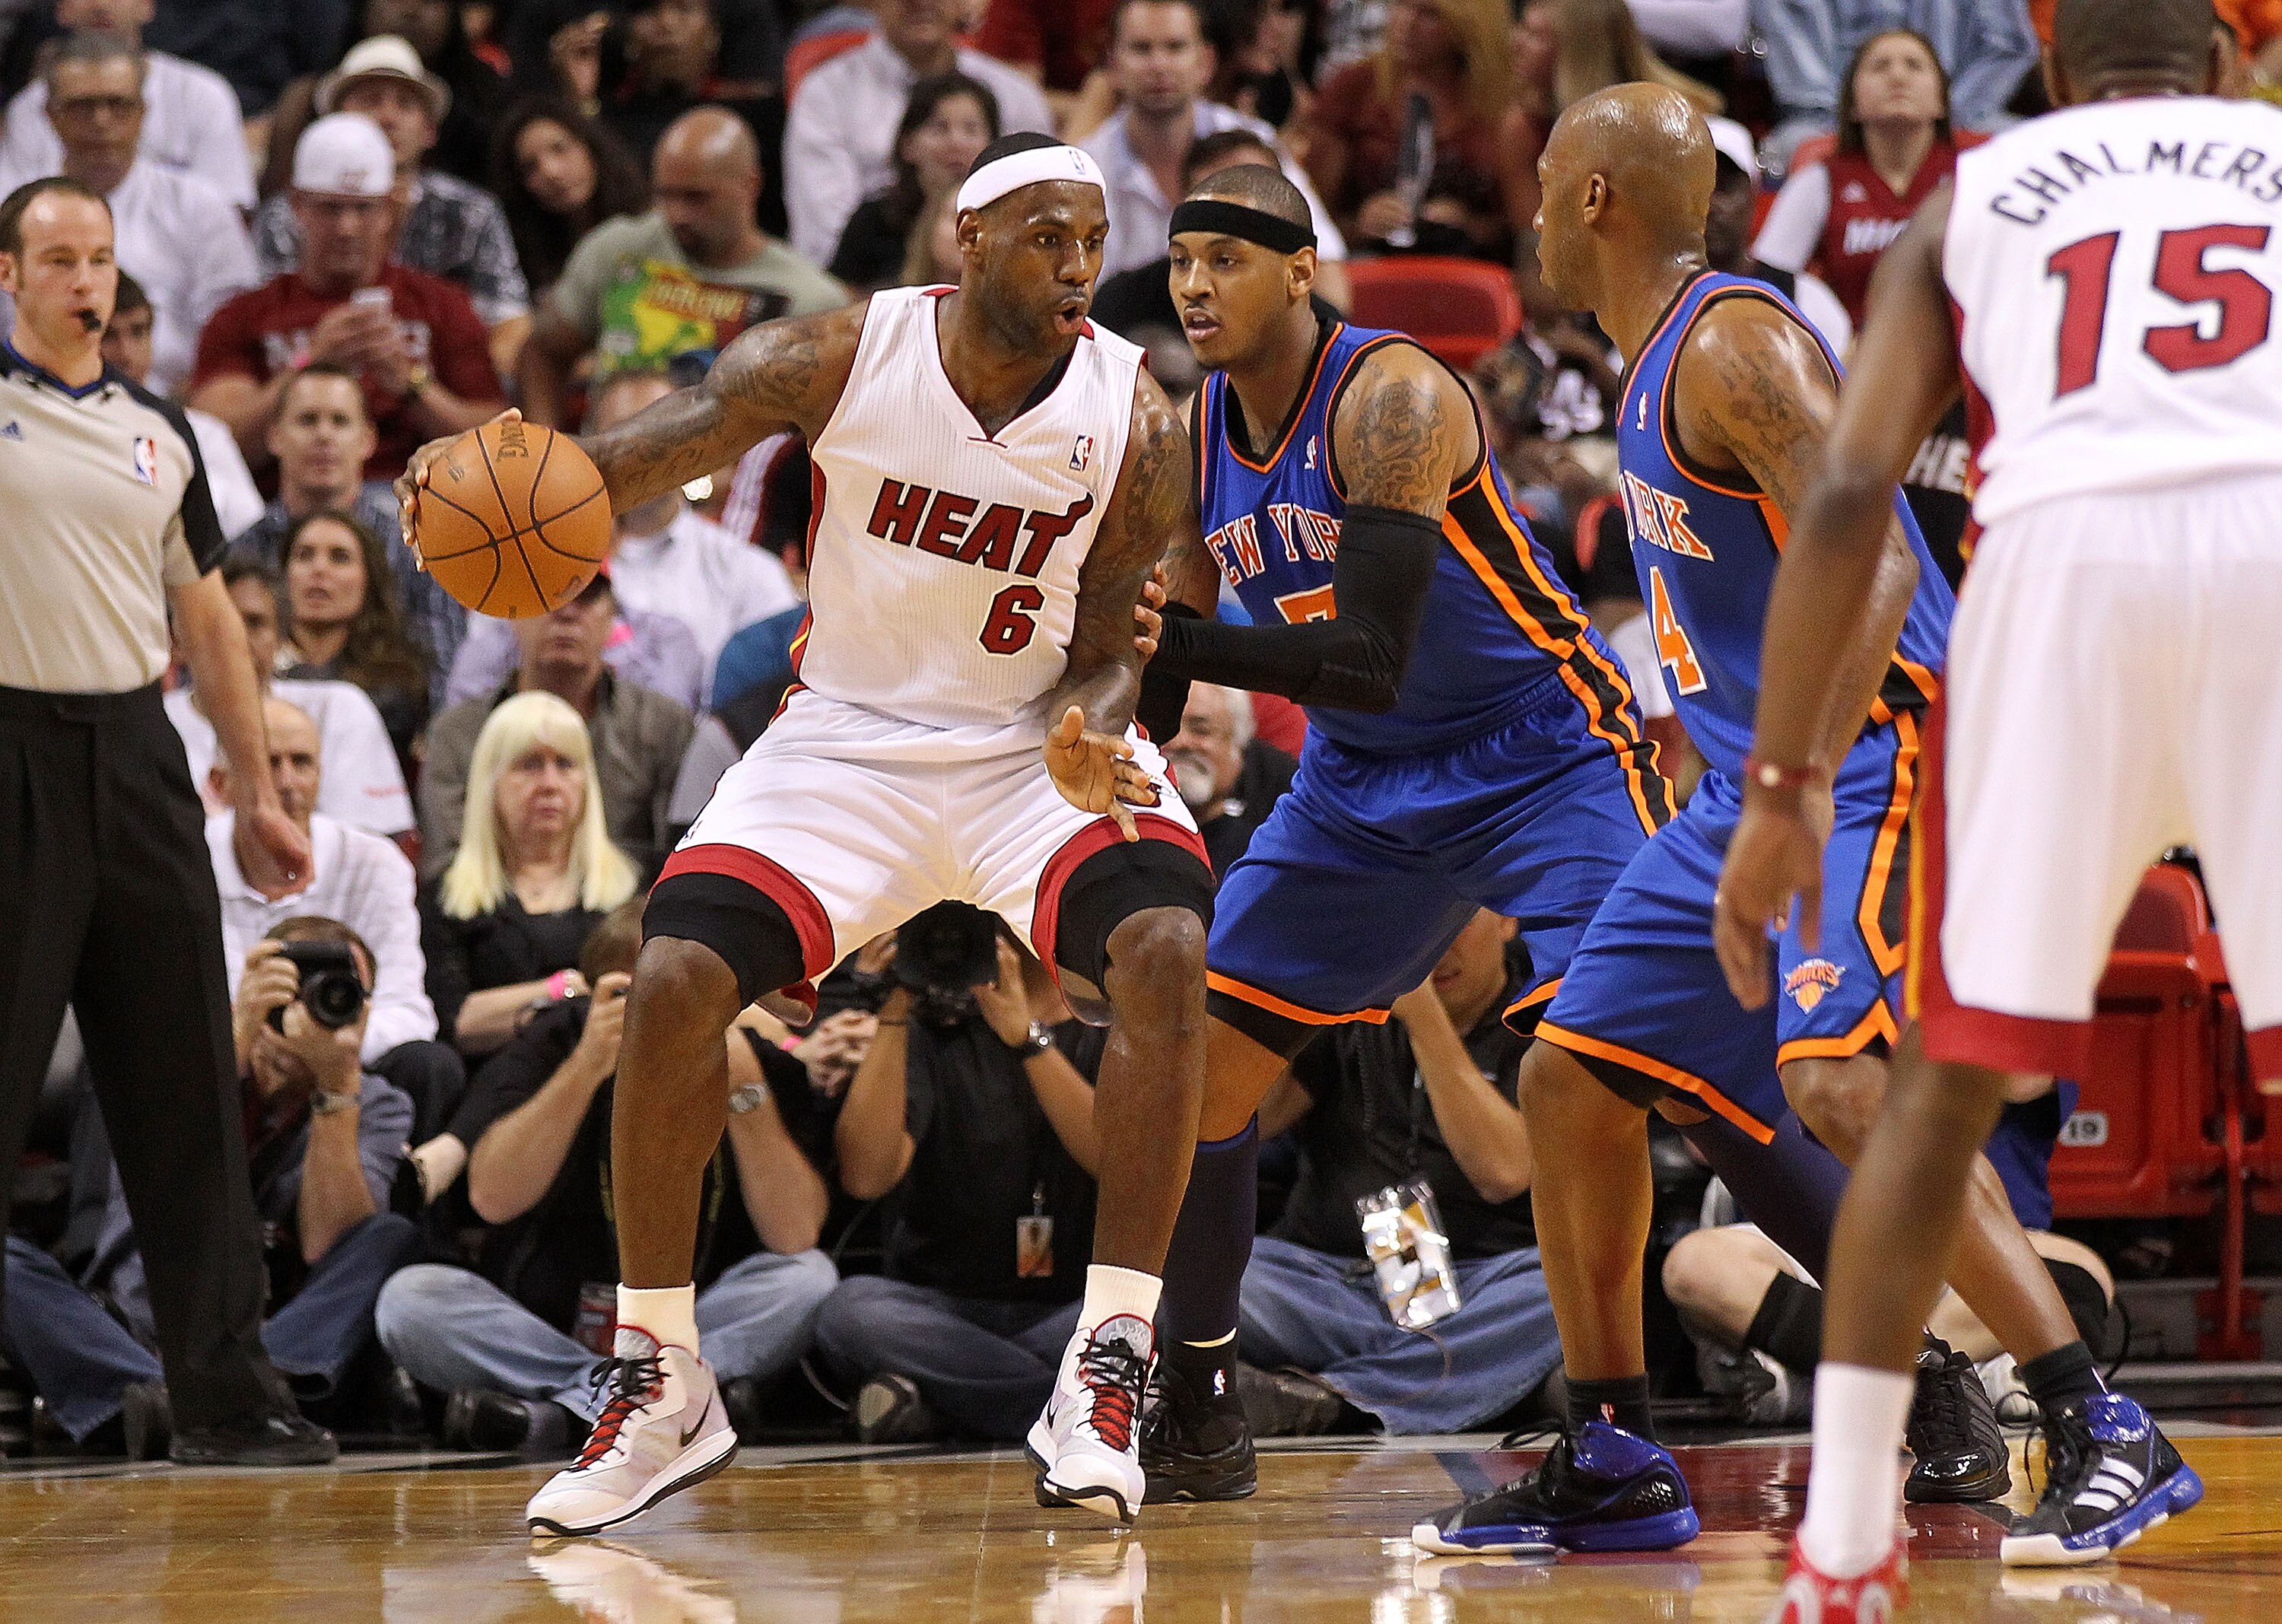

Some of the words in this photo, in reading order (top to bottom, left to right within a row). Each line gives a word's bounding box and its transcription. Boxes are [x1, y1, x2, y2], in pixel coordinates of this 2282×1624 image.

[1988, 139, 2282, 225] CHALMERS
[2045, 224, 2273, 398] 15
[1903, 434, 1970, 494] HE
[866, 477, 1094, 579] HEAT
[1205, 513, 1266, 586] EW
[1267, 503, 1343, 563] YOR
[1619, 469, 1715, 562] ORK
[977, 581, 1047, 657] 6
[1649, 565, 1708, 697] 4
